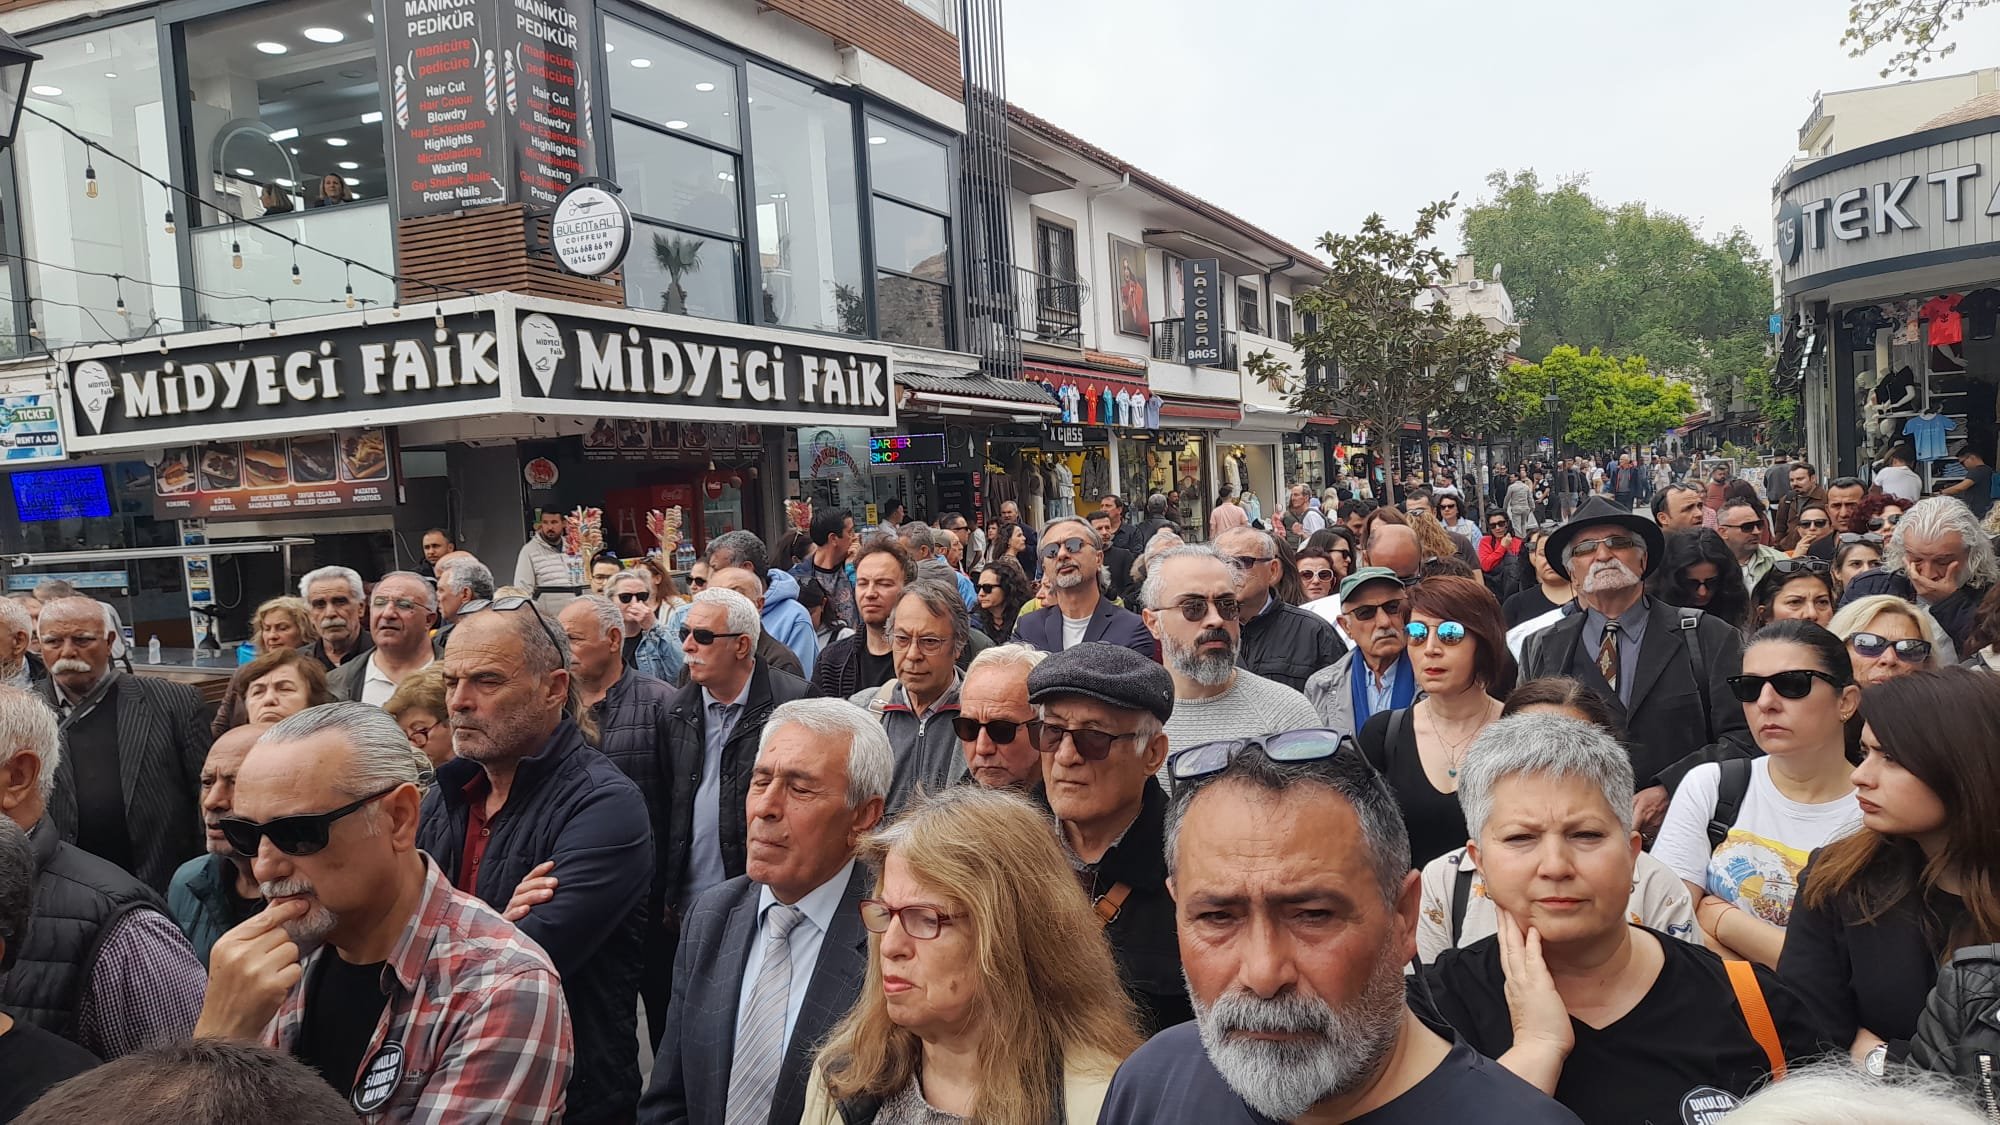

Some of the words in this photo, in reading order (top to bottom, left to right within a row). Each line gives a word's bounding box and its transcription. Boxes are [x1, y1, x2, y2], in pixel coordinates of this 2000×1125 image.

[408, 10, 475, 38] PEDİKÜR
[517, 14, 578, 51] PEDİKÜR
[426, 85, 445, 97] Hair
[448, 81, 466, 93] Cut
[532, 85, 550, 100] Hair
[552, 91, 569, 106] Cut
[420, 100, 439, 111] Hair
[442, 95, 473, 108] Colour
[527, 96, 544, 109] Hair
[546, 104, 577, 120] Colour
[427, 108, 467, 123] Blowdry
[533, 111, 571, 133] Blowdry
[411, 128, 430, 138] Hair
[432, 120, 486, 135] Extensions
[519, 119, 538, 134] Hair
[424, 134, 473, 151] Highlights
[531, 136, 577, 158] Highlights
[432, 162, 468, 175] Waxing
[538, 163, 571, 183] Waxing
[423, 190, 454, 203] Protez
[456, 185, 481, 198] Nails
[531, 186, 558, 203] Protez
[565, 232, 608, 245] COIFFEUR
[1188, 349, 1217, 360] BAGS
[17, 408, 52, 420] TICKET
[16, 436, 35, 444] RENT
[35, 435, 42, 443] A
[42, 435, 57, 443] CAR
[1050, 427, 1056, 440] X
[870, 438, 911, 449] BARBER
[871, 452, 899, 463] SHOP
[1689, 1095, 1734, 1111] OKULDA
